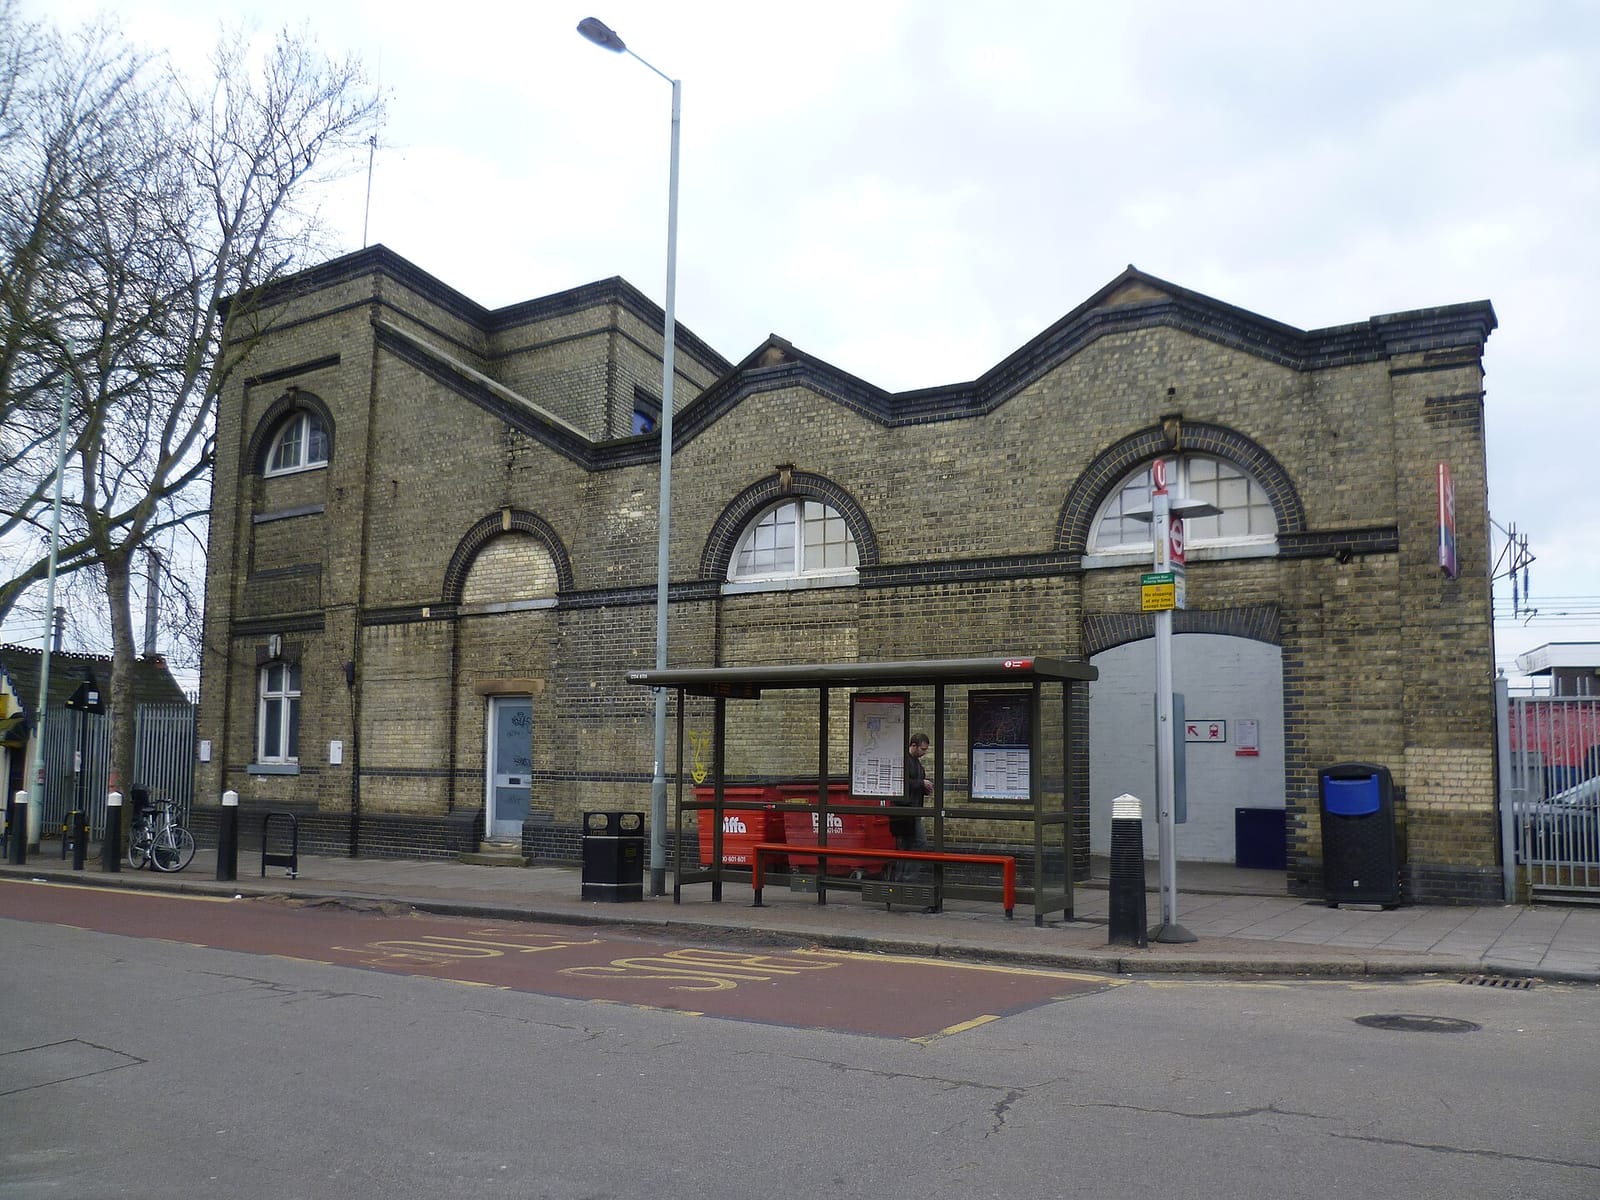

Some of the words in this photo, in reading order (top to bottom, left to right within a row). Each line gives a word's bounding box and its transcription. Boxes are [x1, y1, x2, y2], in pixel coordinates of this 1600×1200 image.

[1158, 464, 1166, 486] U
[812, 812, 843, 827] Bffa
[557, 949, 843, 991] BUS
